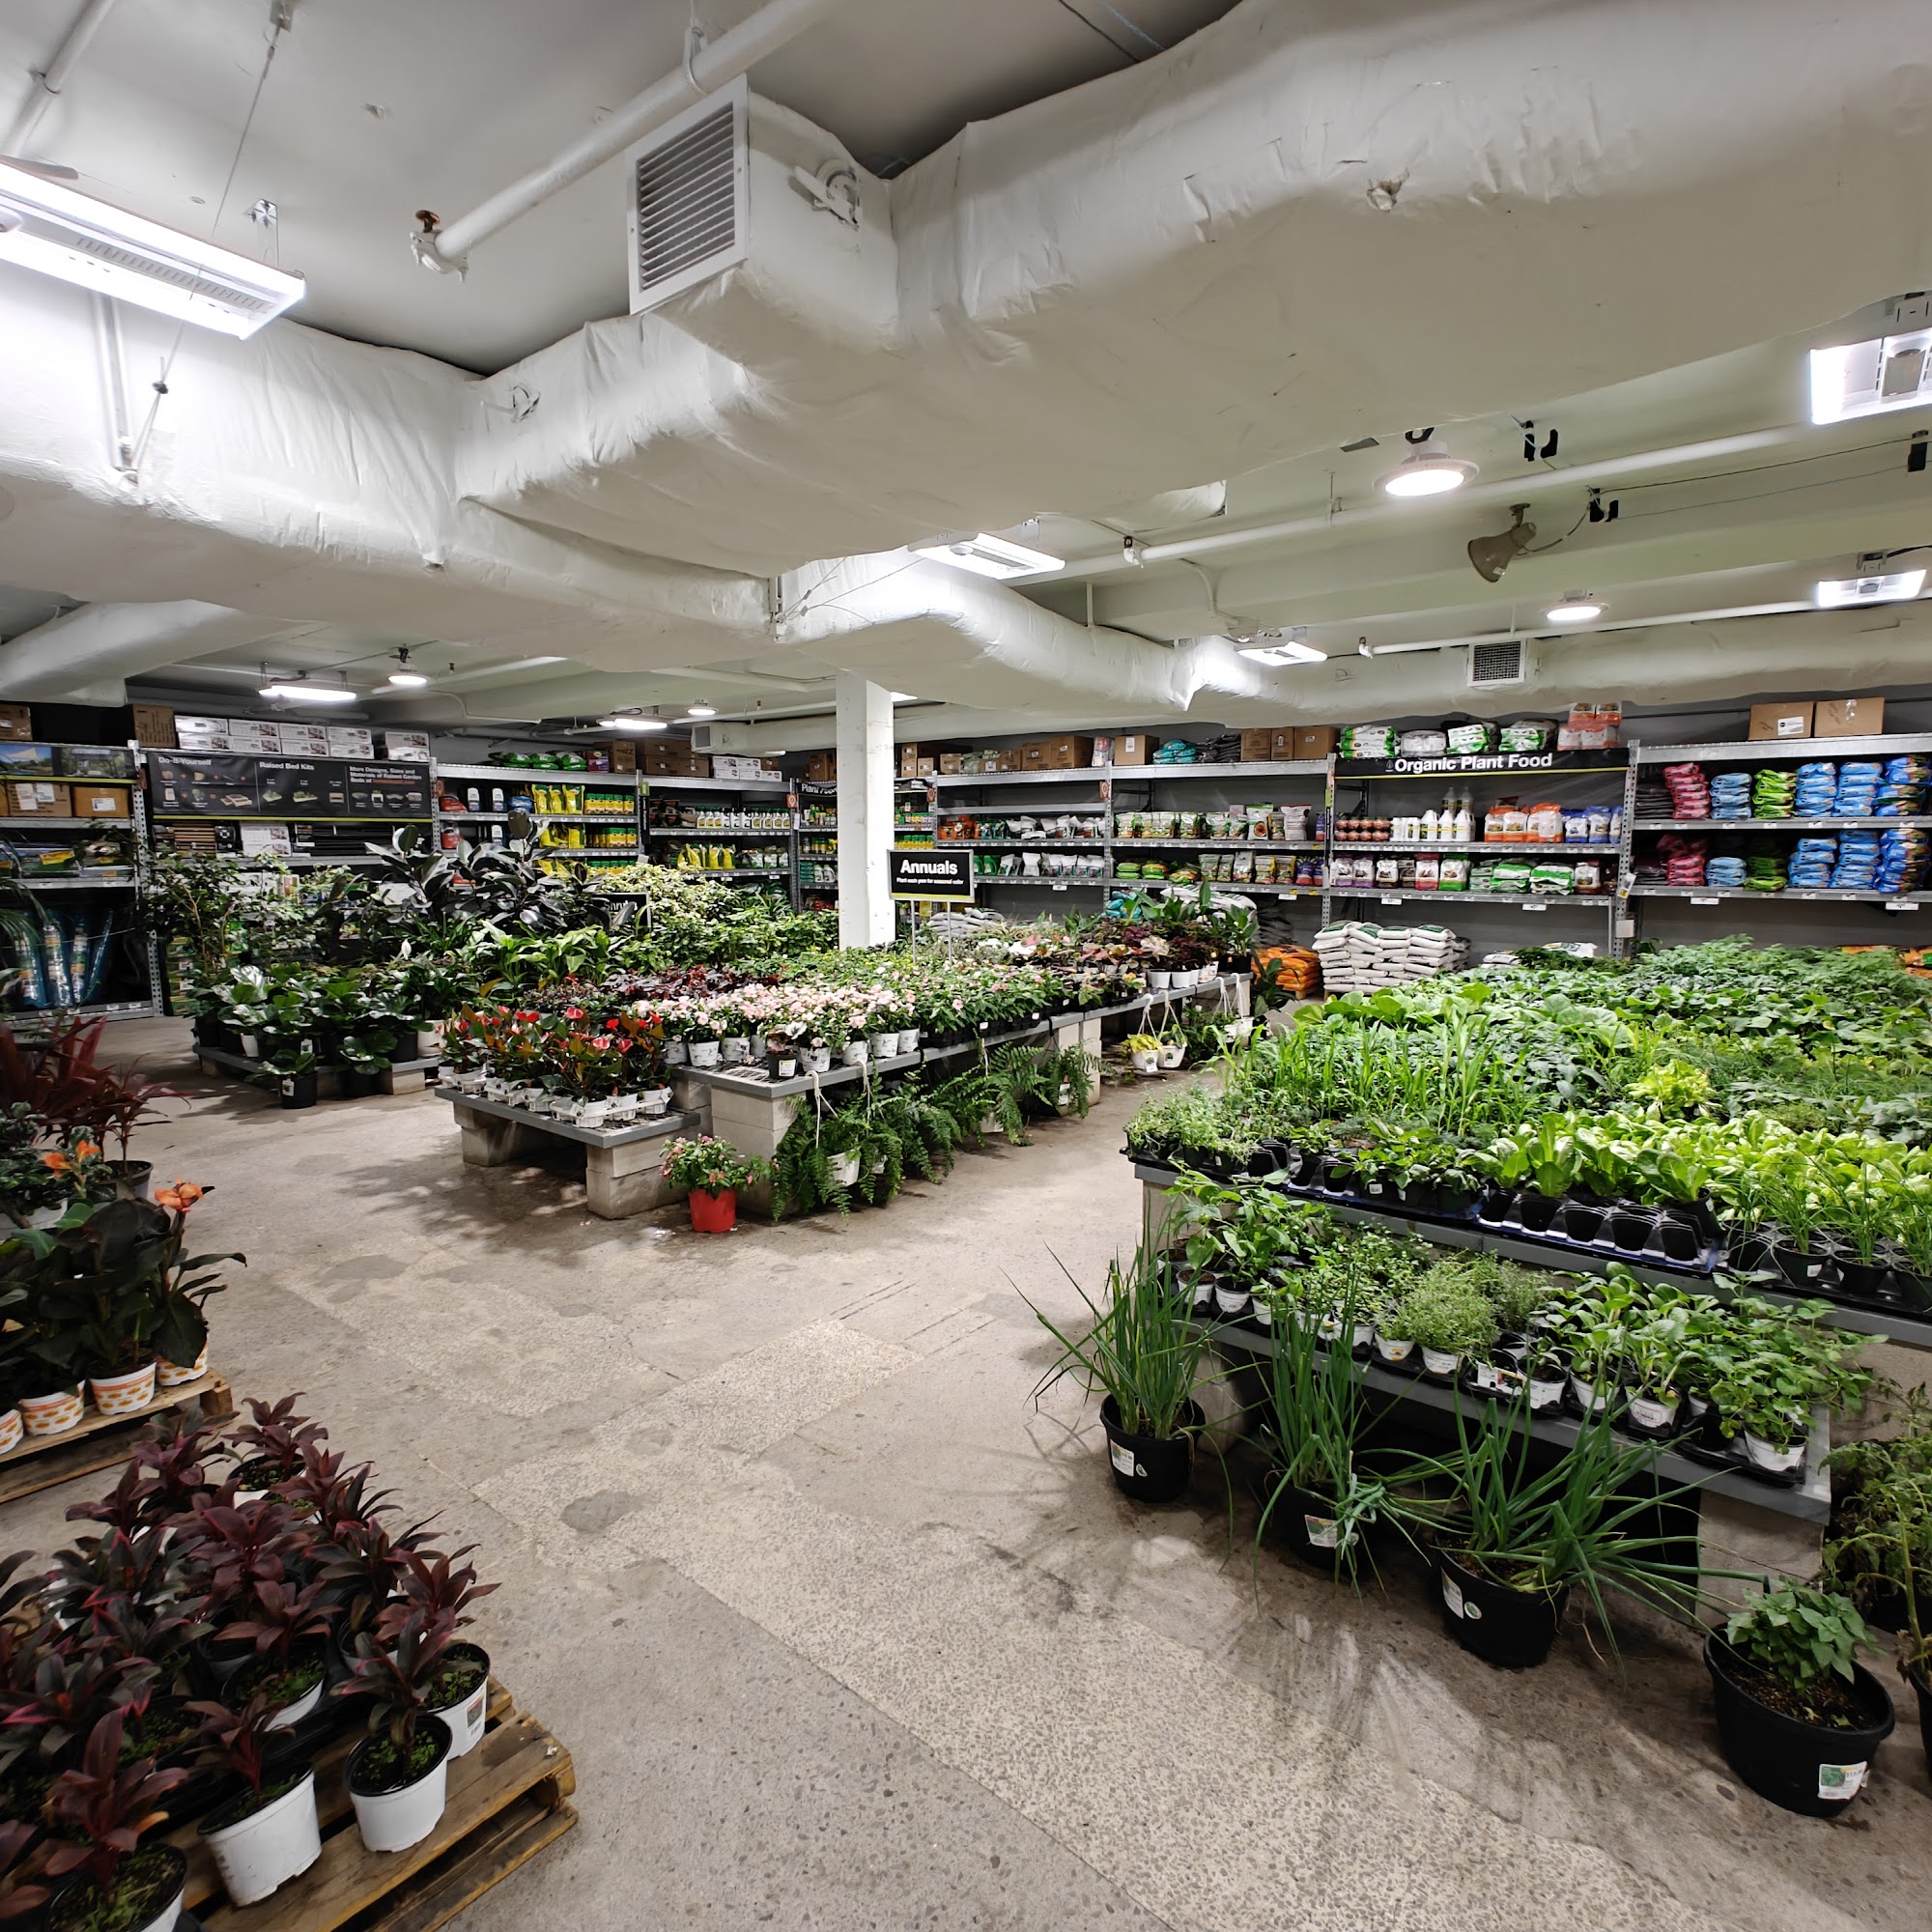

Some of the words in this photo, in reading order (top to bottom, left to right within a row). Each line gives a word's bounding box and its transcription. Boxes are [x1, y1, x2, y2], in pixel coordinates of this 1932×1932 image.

[158, 757, 212, 766] Do-It-Yourself
[1394, 757, 1457, 774] Organic
[1461, 754, 1503, 770] Plant
[1507, 753, 1552, 768] Food
[900, 859, 958, 875] Annuals
